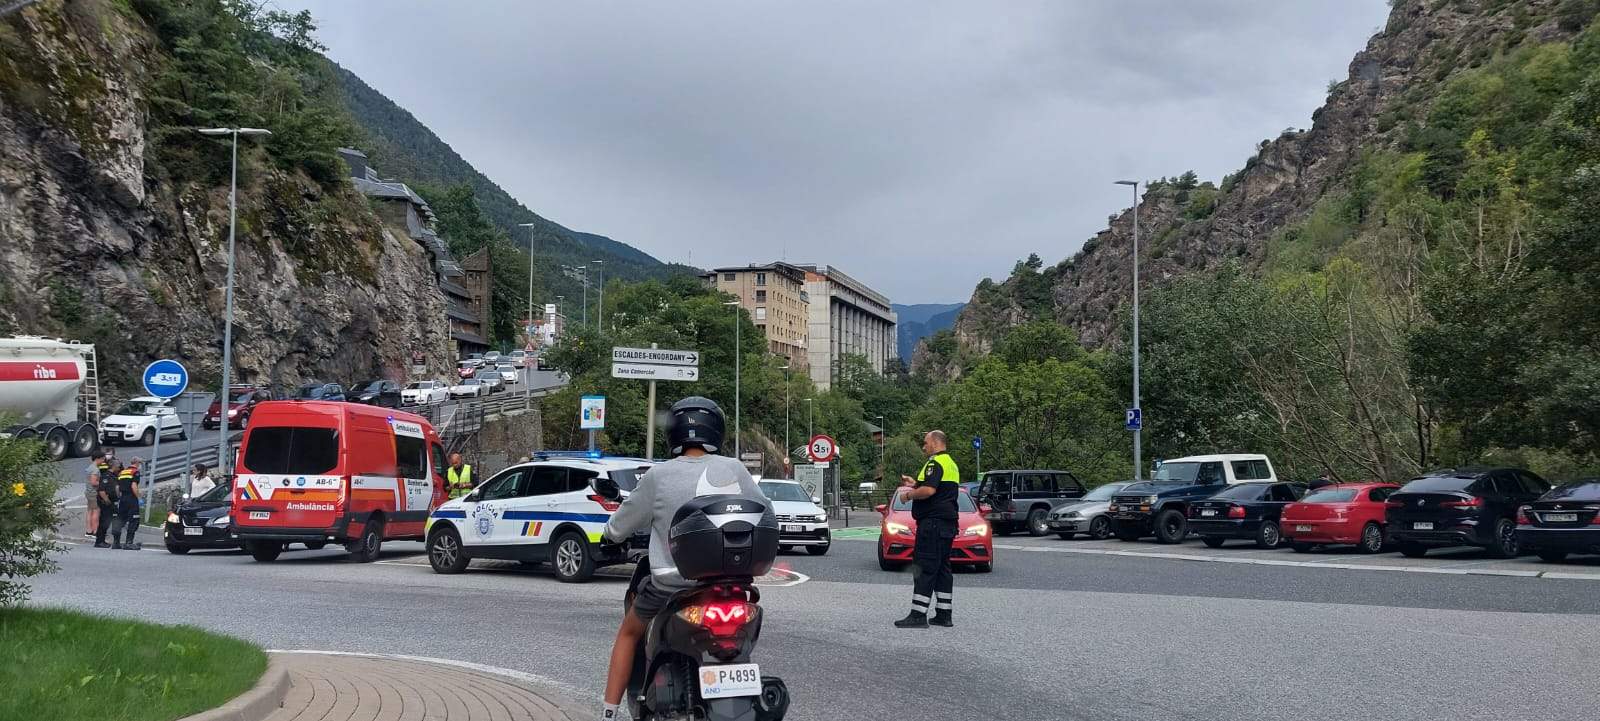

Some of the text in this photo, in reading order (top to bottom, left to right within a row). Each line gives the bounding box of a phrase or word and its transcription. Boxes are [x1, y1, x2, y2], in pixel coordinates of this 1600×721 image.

[614, 350, 686, 361] ESCALDES-ENGORDANY
[33, 364, 56, 378] riba
[1127, 410, 1135, 424] P
